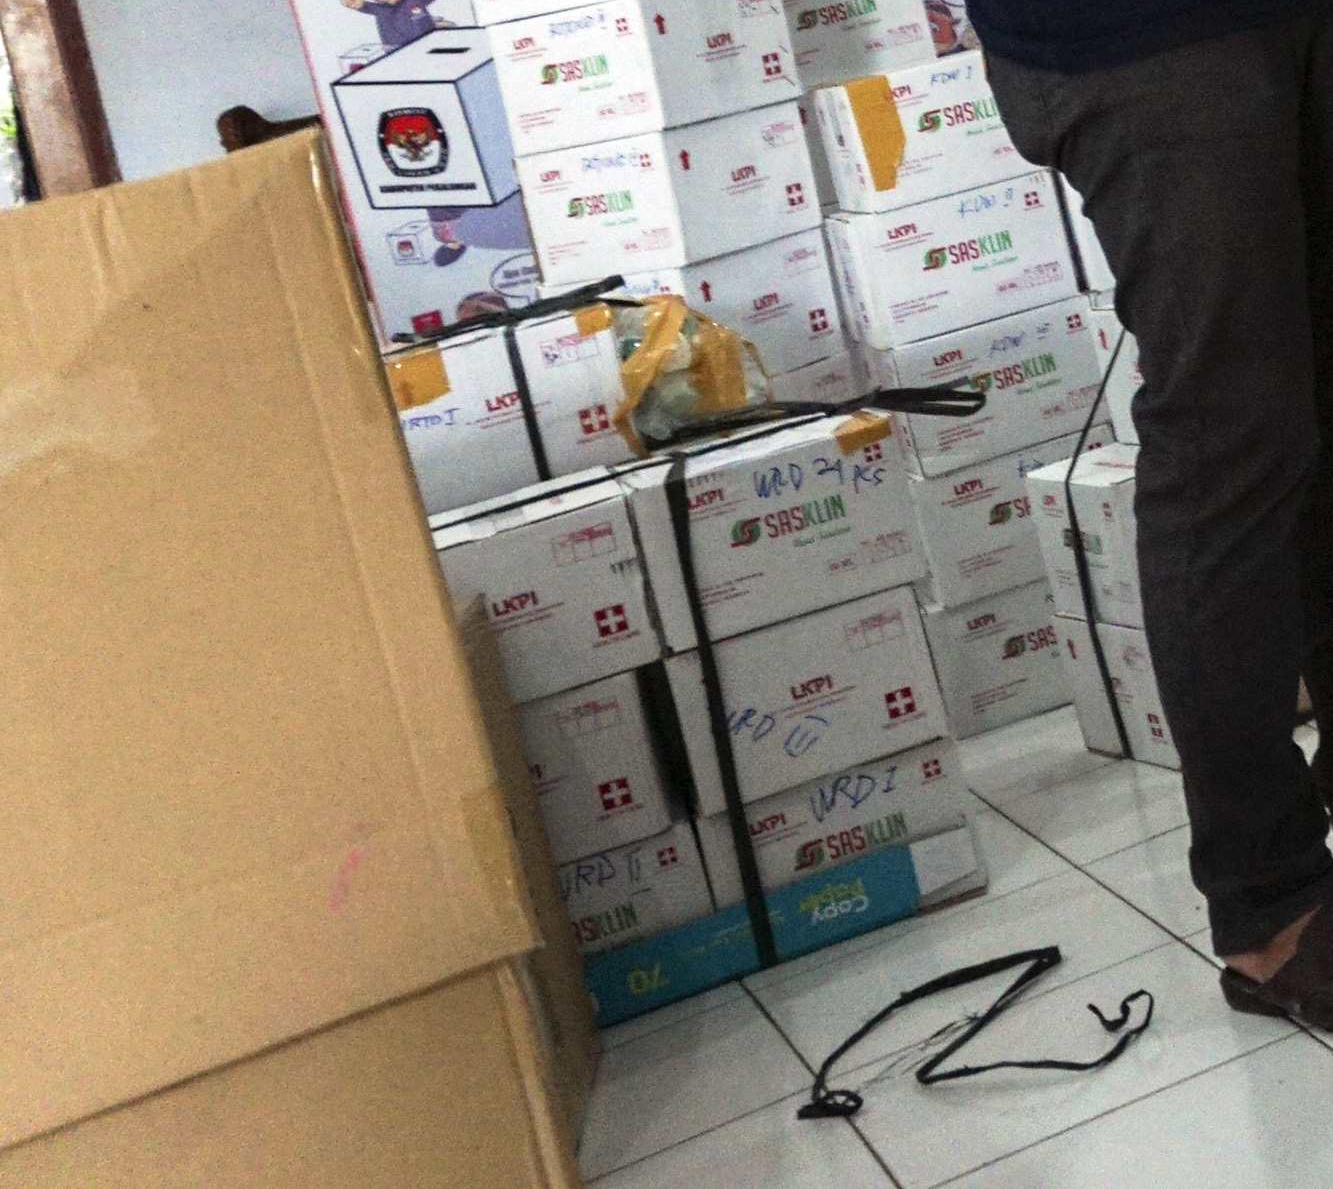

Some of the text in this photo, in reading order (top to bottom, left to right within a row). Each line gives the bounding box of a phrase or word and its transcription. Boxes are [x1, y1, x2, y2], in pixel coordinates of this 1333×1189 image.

[948, 229, 1014, 265] SASKLIN
[932, 348, 964, 368] LKPI
[992, 352, 1058, 391] SASKLIN
[764, 493, 847, 539] SASKLIN
[492, 589, 539, 618] LKPI
[790, 673, 834, 701] LKPI
[825, 811, 908, 859] SASKLIN
